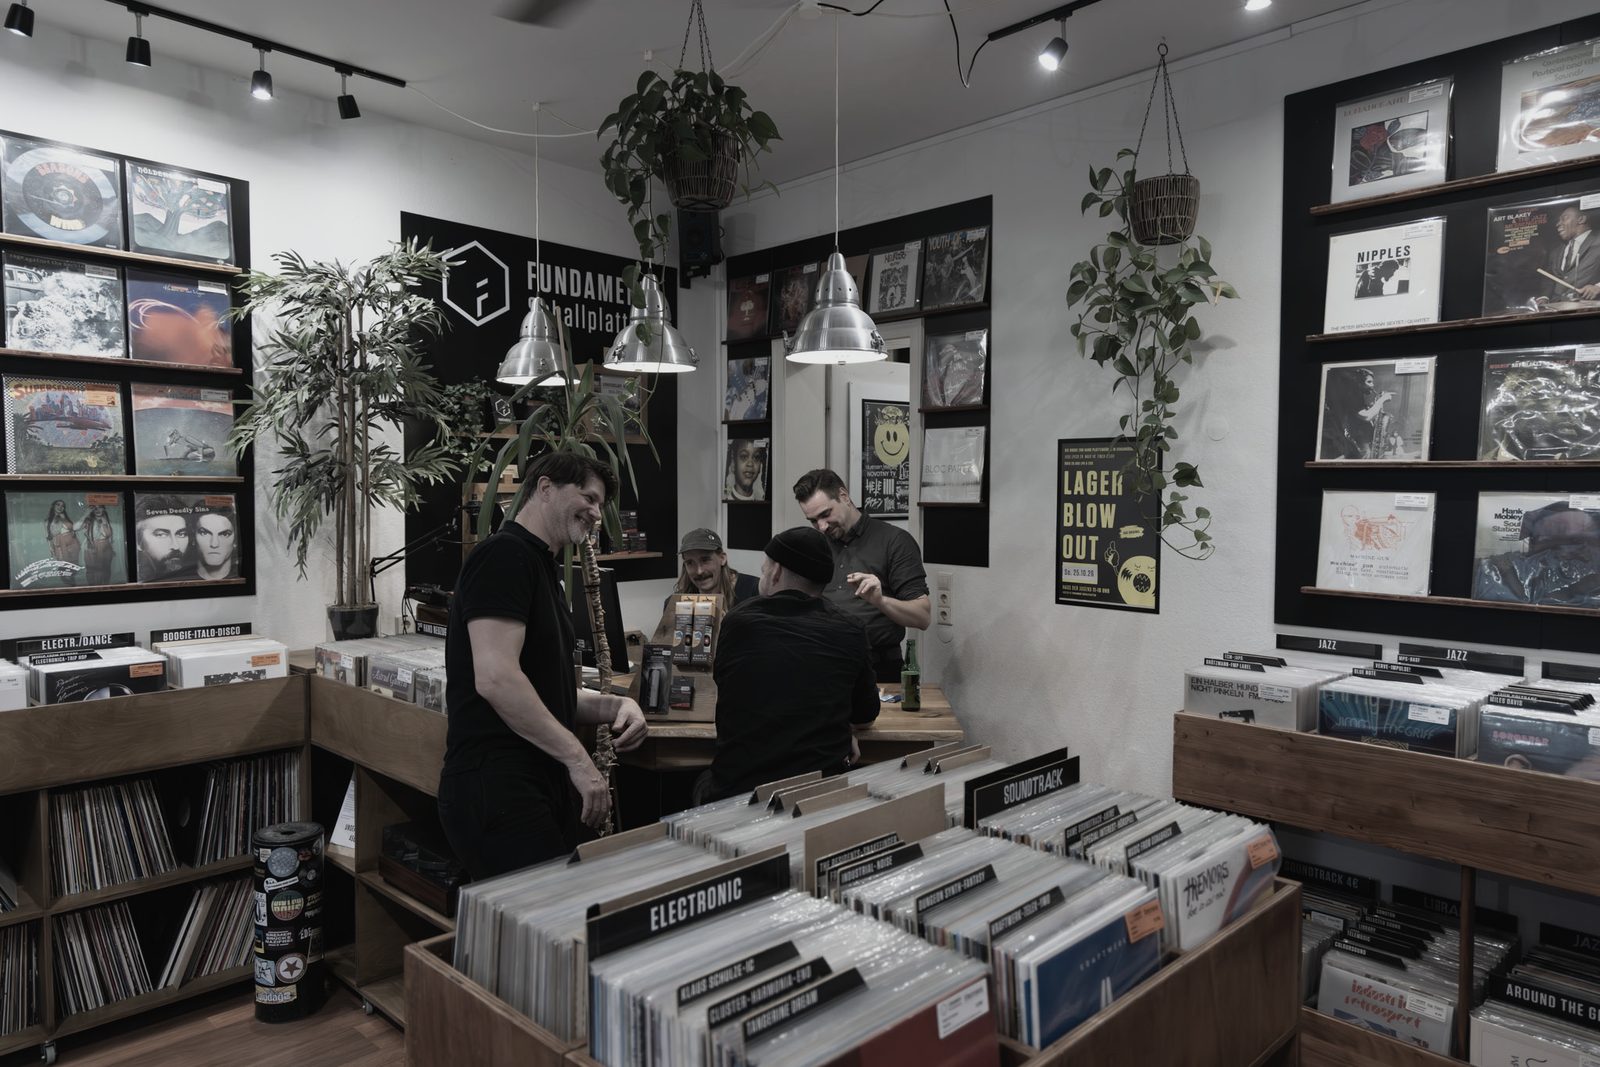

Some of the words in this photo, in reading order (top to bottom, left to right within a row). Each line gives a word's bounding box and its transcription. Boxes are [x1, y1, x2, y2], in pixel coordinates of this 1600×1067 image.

[1507, 212, 1532, 220] BLAKEY
[928, 236, 950, 251] YOUTH
[1356, 245, 1411, 264] NIPPLES
[527, 260, 632, 306] FUNDAME
[925, 464, 947, 474] BLOC
[1063, 470, 1124, 496] LAGER
[146, 508, 168, 516] Seven
[169, 506, 193, 515] Deadly
[195, 505, 209, 513] Sins
[1063, 502, 1116, 529] BLOW
[1494, 513, 1523, 521] Mobley
[1062, 534, 1099, 561] OUT
[41, 634, 113, 650] ELECTR./DANCE
[162, 626, 241, 641] BOOGIE-ITALO-DISCO
[1318, 639, 1337, 651] JAZZ
[1446, 649, 1468, 662] JAZZ
[1190, 676, 1203, 685] EIN
[1203, 677, 1234, 689] HALBER
[1236, 682, 1259, 692] HUND
[1190, 684, 1214, 693] NICHT
[1214, 687, 1244, 698] PINKELN
[1489, 696, 1506, 704] MILES
[1507, 698, 1523, 707] DAVIS
[1003, 766, 1064, 806] SOUNDTRACK
[820, 860, 830, 873] THE
[841, 855, 893, 884] INDUSTRIAL-NOISE
[918, 890, 943, 911] DUNGEON
[945, 872, 986, 899] SYNTH-FANTASY
[1183, 861, 1229, 907] TREMORS
[649, 877, 743, 932] ELECTRONIC
[1423, 895, 1458, 916] LIBRA
[1358, 923, 1376, 933] LIBRARY
[680, 978, 707, 1001] KLAUS
[1506, 983, 1556, 1008] AROUND
[1560, 998, 1584, 1016] THE
[746, 1002, 790, 1036] TANGERINE
[790, 989, 819, 1014] DREAM
